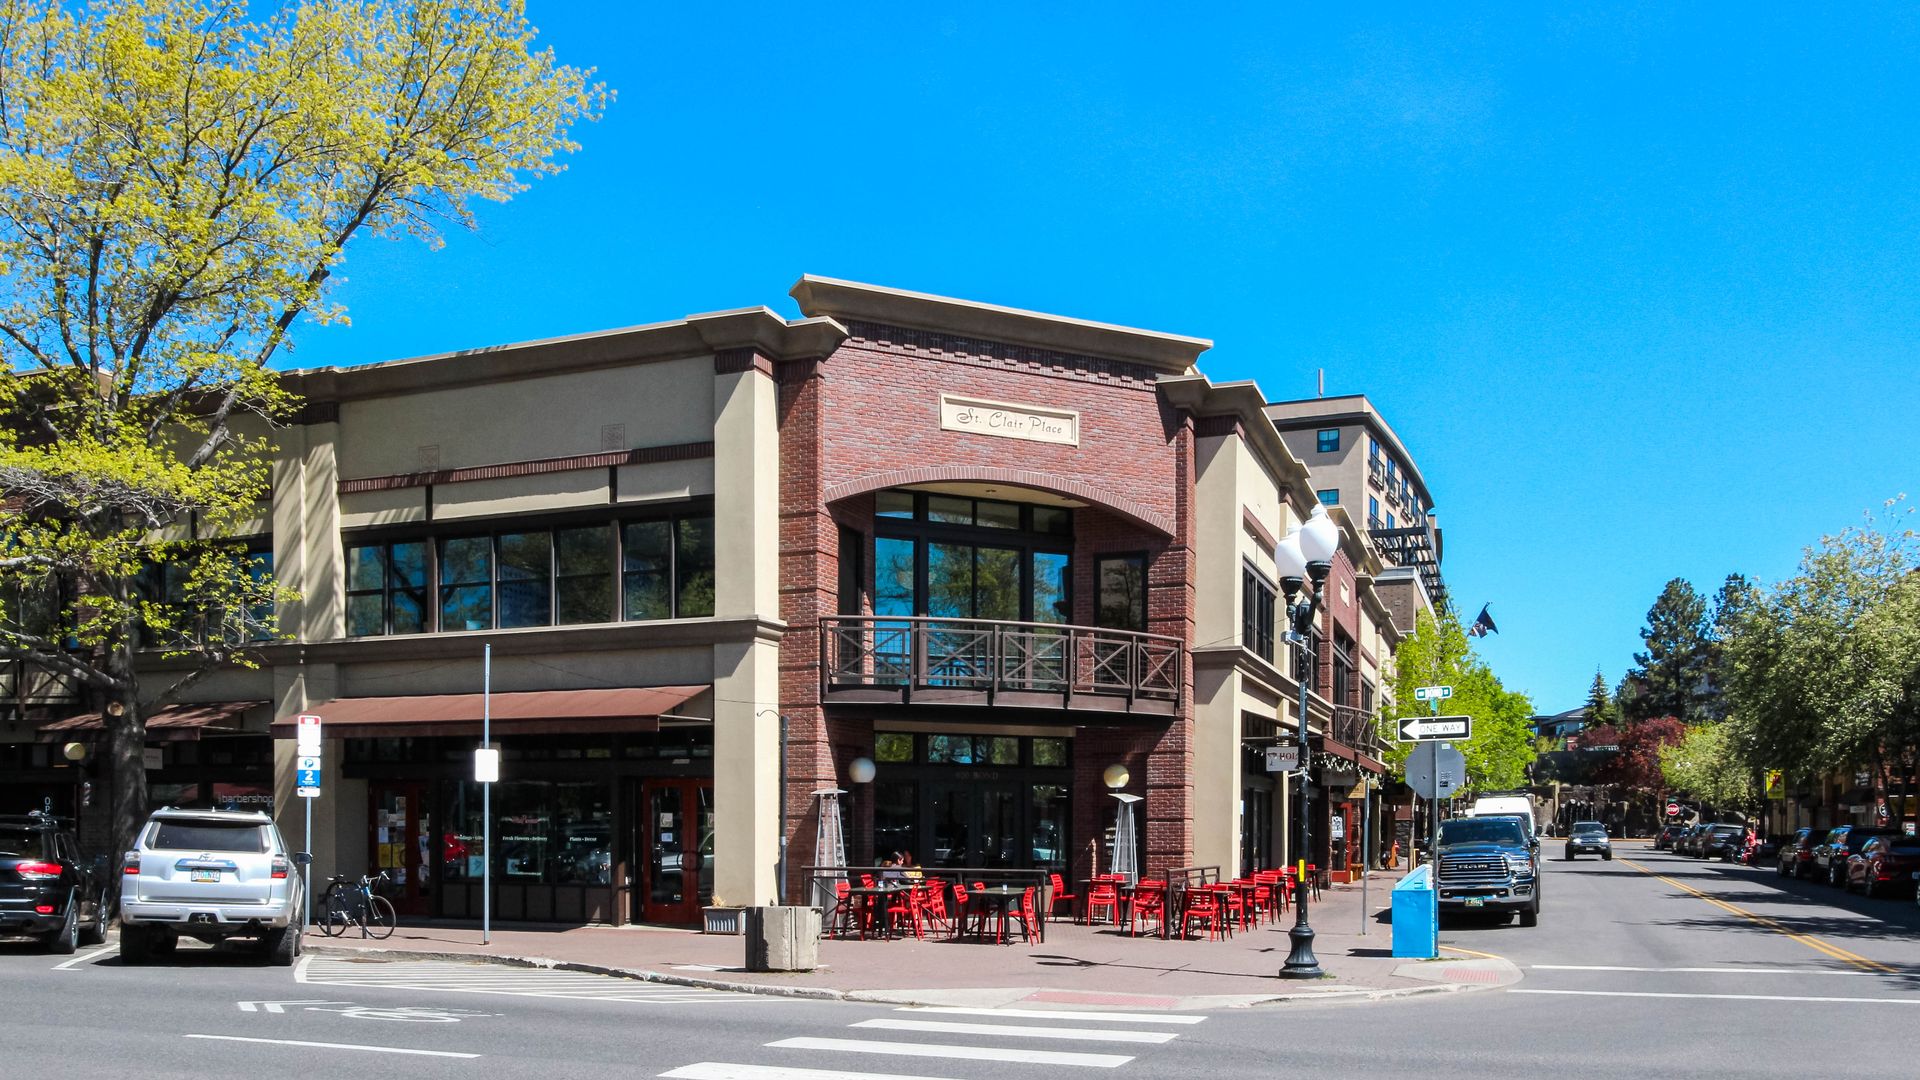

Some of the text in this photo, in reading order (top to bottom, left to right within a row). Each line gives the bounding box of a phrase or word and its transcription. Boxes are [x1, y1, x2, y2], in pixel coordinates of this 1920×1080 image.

[956, 408, 1062, 434] St. Clair Place
[1419, 723, 1462, 733] ONE WAY
[304, 770, 313, 781] 2
[221, 793, 274, 804] barbershop
